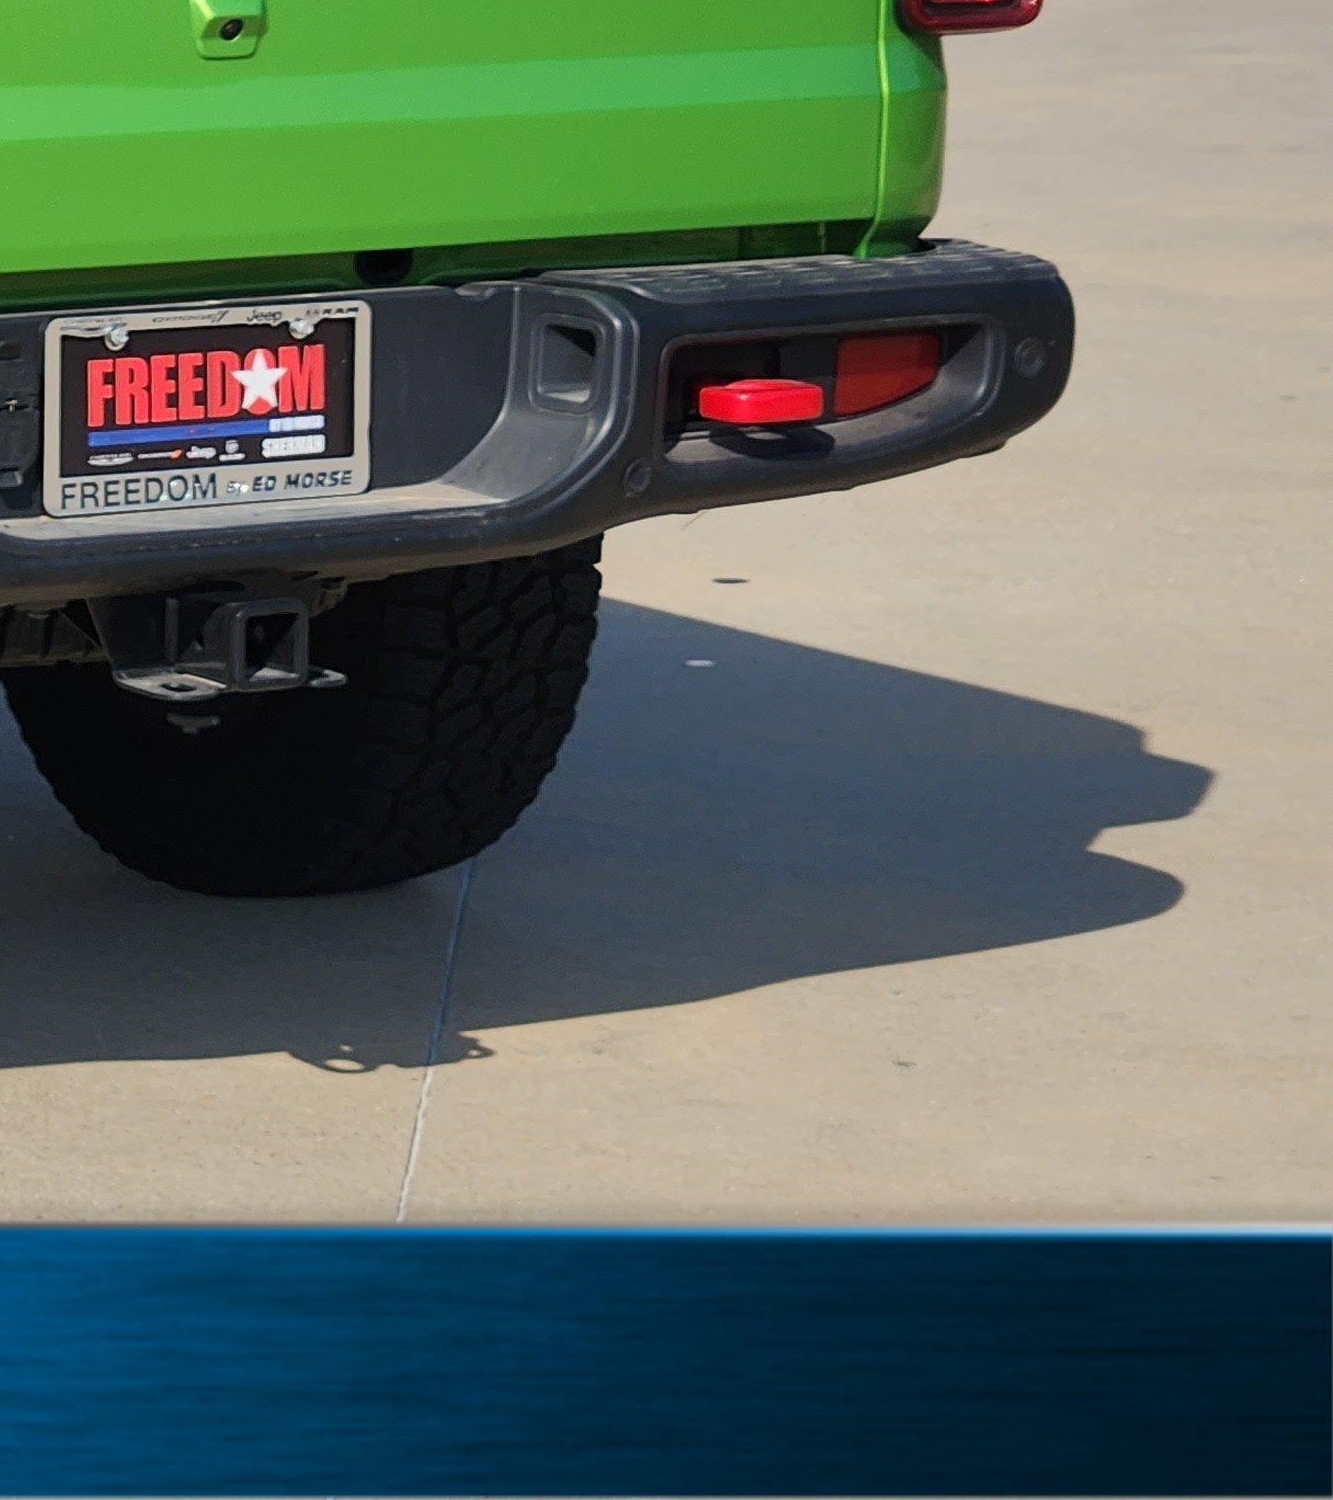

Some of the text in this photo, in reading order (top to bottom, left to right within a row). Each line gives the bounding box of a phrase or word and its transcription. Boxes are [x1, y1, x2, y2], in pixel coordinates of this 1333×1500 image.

[246, 308, 283, 323] Jeep
[86, 343, 325, 428] FREEDOM
[61, 473, 218, 509] FREEDOM
[252, 475, 277, 492] ED
[283, 470, 353, 490] MORSE
